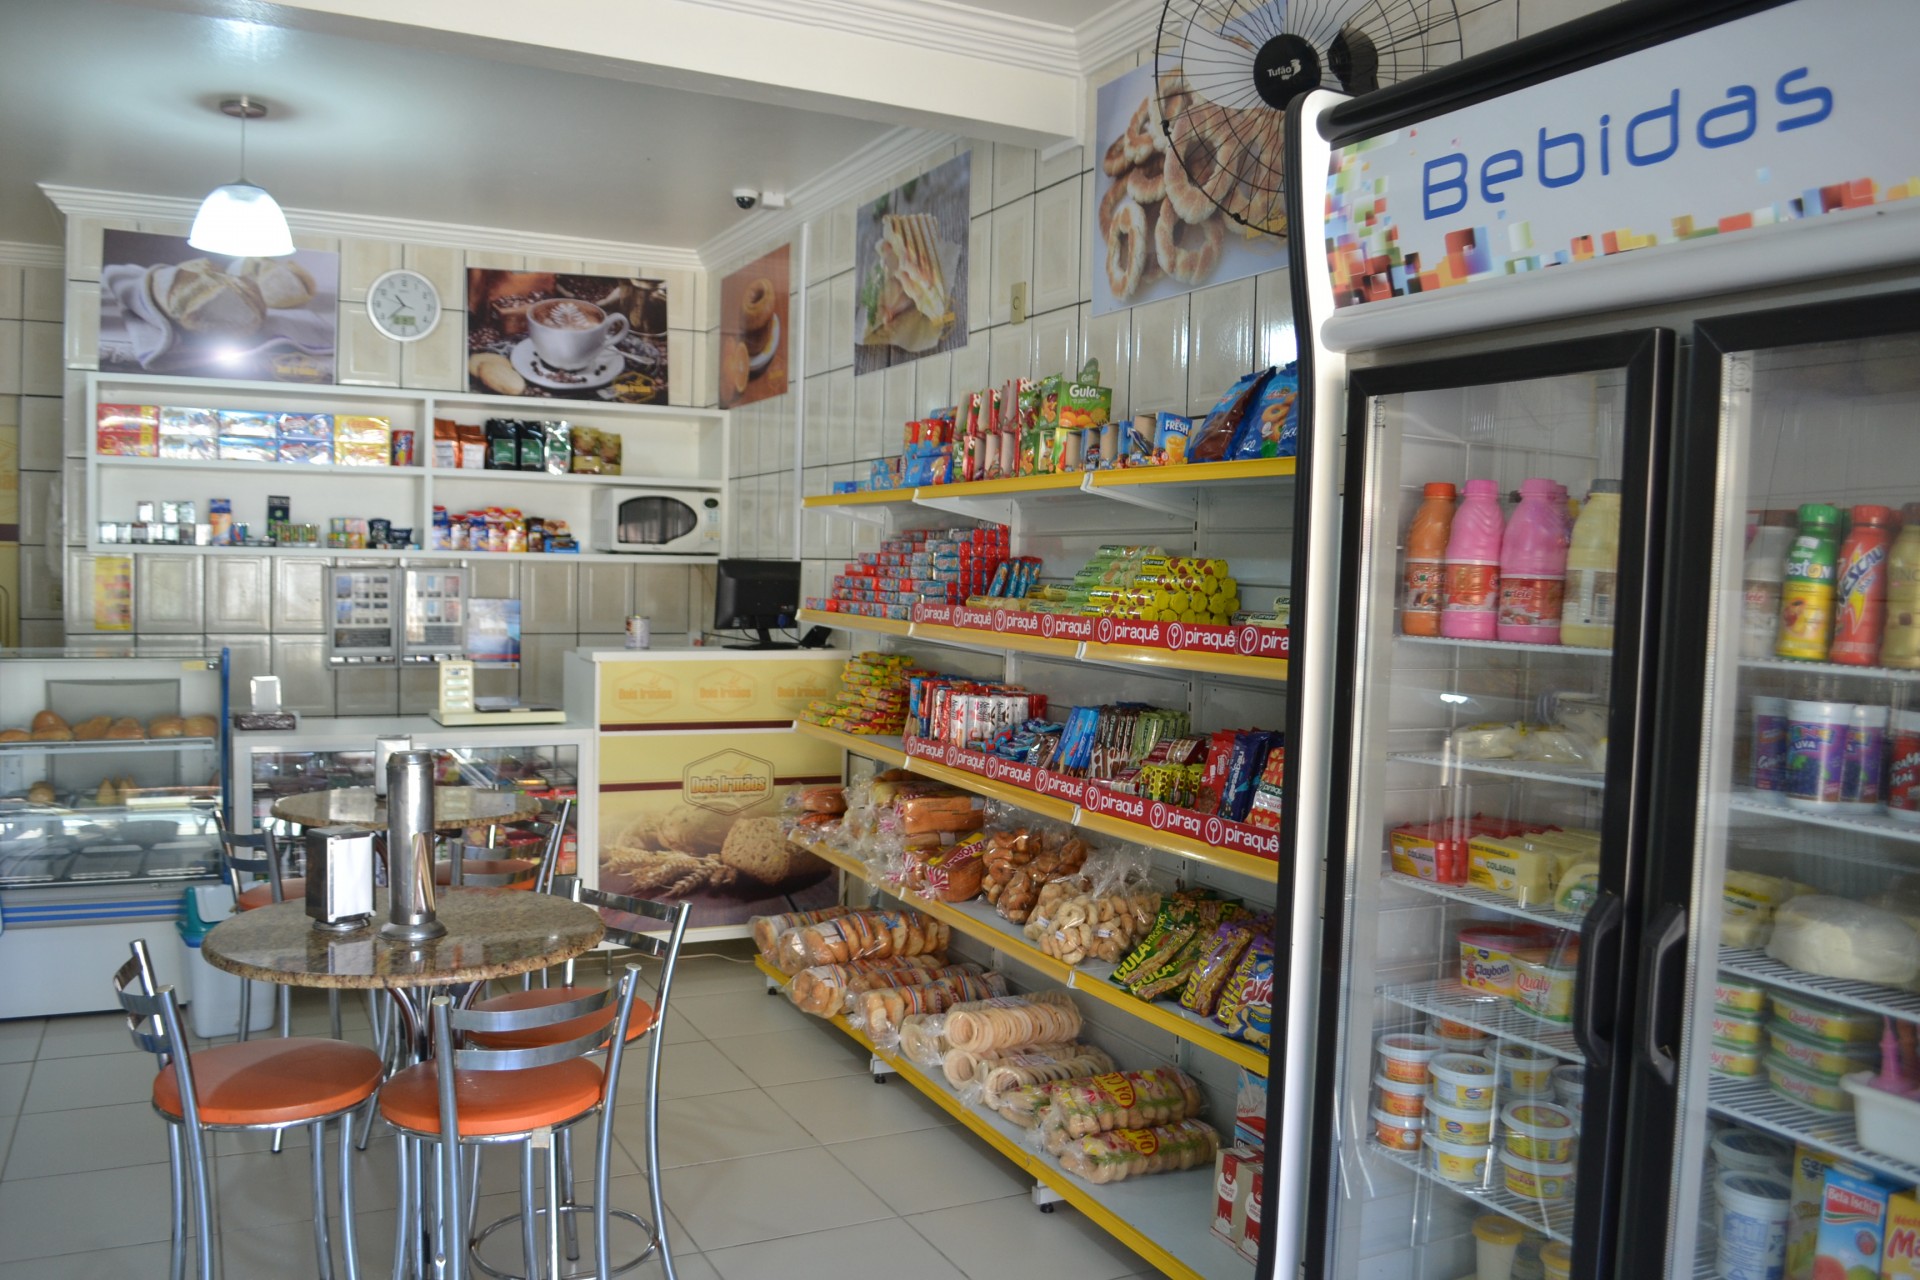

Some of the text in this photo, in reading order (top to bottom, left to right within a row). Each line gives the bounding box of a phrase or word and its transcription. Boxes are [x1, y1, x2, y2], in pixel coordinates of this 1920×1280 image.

[1267, 66, 1292, 77] Tufão
[1423, 67, 1833, 220] Bebidas
[1069, 384, 1097, 398] Gula
[1165, 420, 1189, 436] FRESH
[924, 606, 950, 621] piraquê
[963, 609, 991, 625] piraquê
[1006, 612, 1037, 630] piraquê
[1055, 615, 1091, 635] piraquê
[1114, 622, 1160, 643] piraquê
[1185, 628, 1236, 649] piraquê
[916, 741, 944, 758] piraquê
[1794, 740, 1816, 749] UVA
[956, 751, 985, 770] piraquê
[999, 762, 1031, 782] piraquê
[691, 774, 767, 793] Dois Irmãos
[1048, 775, 1082, 798] piraquê
[1101, 793, 1144, 817] piraquê
[1225, 827, 1279, 853] piraquê
[1486, 861, 1516, 876] COLAGUA
[1113, 943, 1151, 981] GULA
[1129, 964, 1174, 992] GULA
[1181, 958, 1209, 1009] GULA
[1828, 1187, 1849, 1204] Bela
